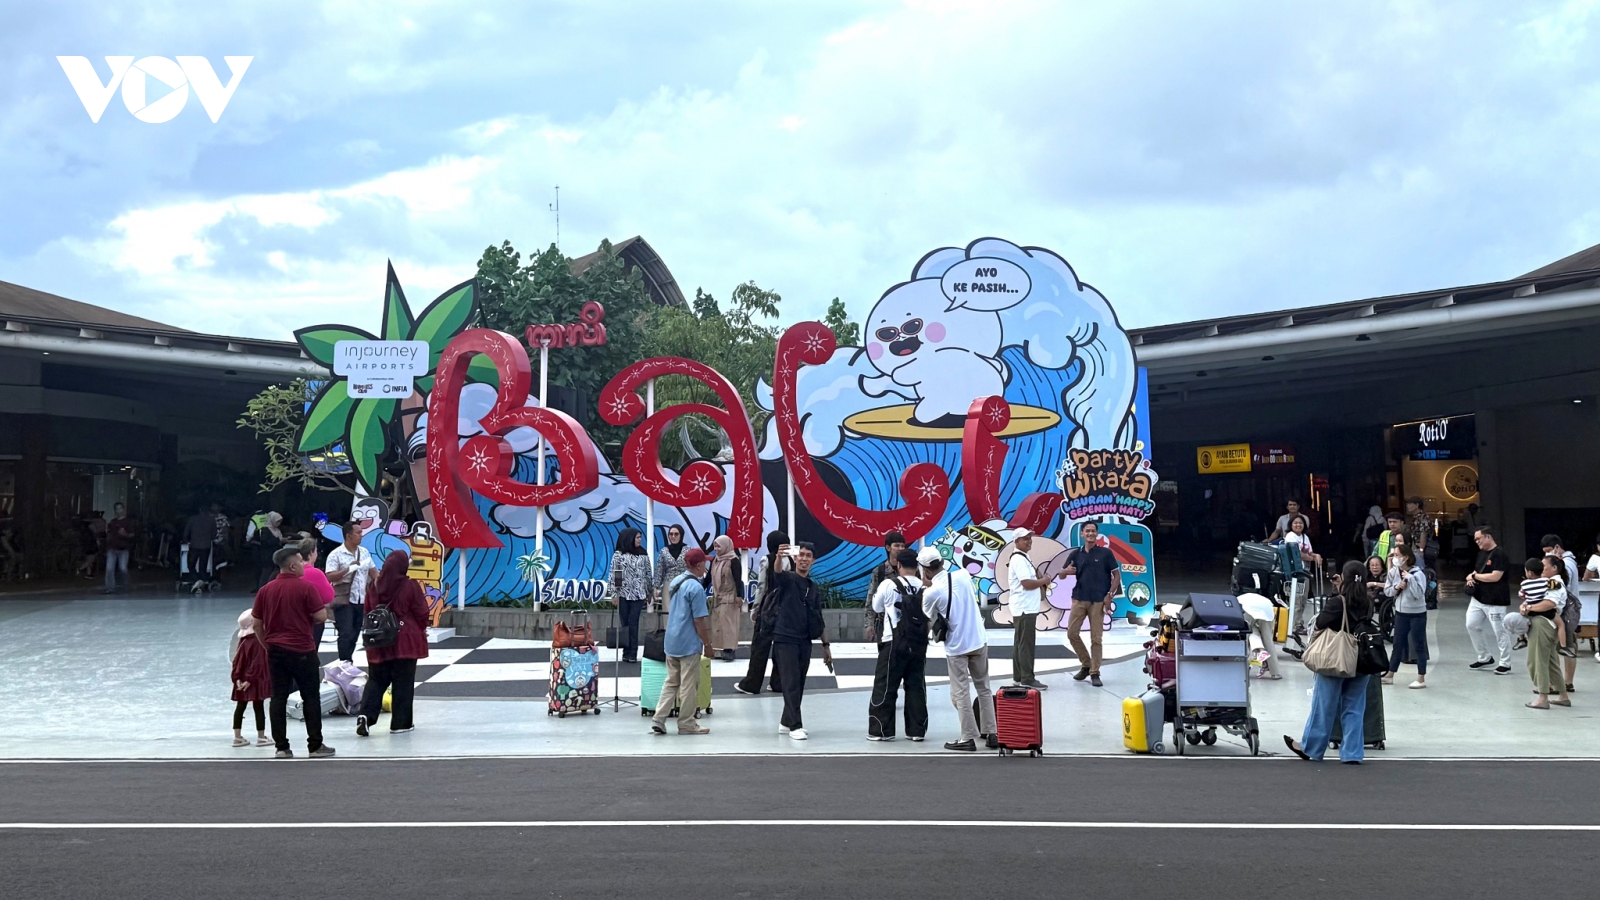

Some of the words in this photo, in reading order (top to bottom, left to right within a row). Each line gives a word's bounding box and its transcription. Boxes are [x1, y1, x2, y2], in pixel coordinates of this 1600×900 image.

[975, 267, 998, 278] AYO
[953, 282, 968, 293] KE
[971, 282, 1019, 294] PASIH...
[1228, 448, 1247, 458] BETUTU
[1063, 494, 1113, 512] LIBURAN
[1115, 495, 1153, 511] HAPPY
[1069, 504, 1117, 519] SEPENUH
[1118, 504, 1145, 518] HATI
[534, 569, 606, 604] ISLAND
